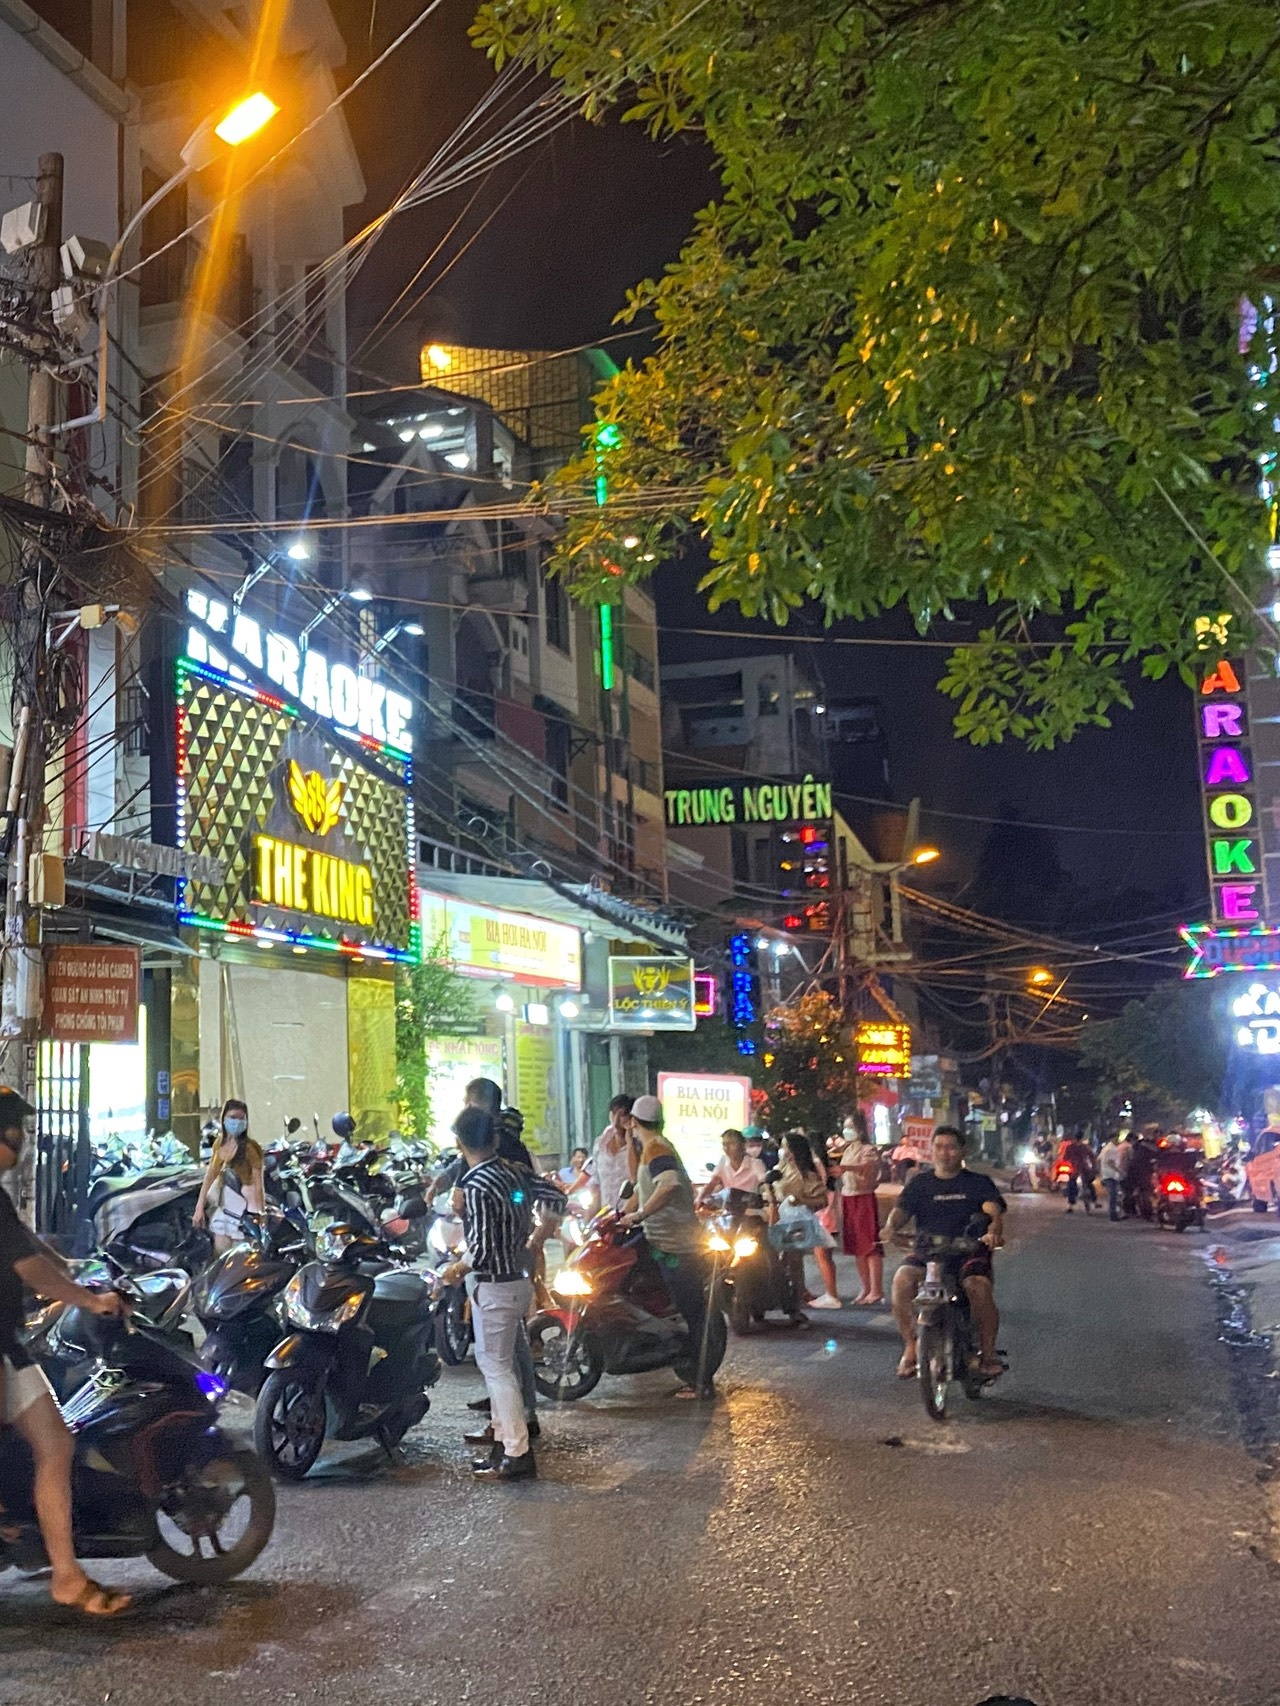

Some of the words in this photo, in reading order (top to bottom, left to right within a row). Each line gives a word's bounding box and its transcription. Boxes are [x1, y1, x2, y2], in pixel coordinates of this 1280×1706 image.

[186, 588, 414, 753] KARAOKE
[664, 787, 736, 825] TRUNG
[743, 774, 833, 823] NGUYÊN
[257, 836, 308, 911] THE
[312, 852, 374, 925] KING
[677, 1086, 700, 1100] BIA
